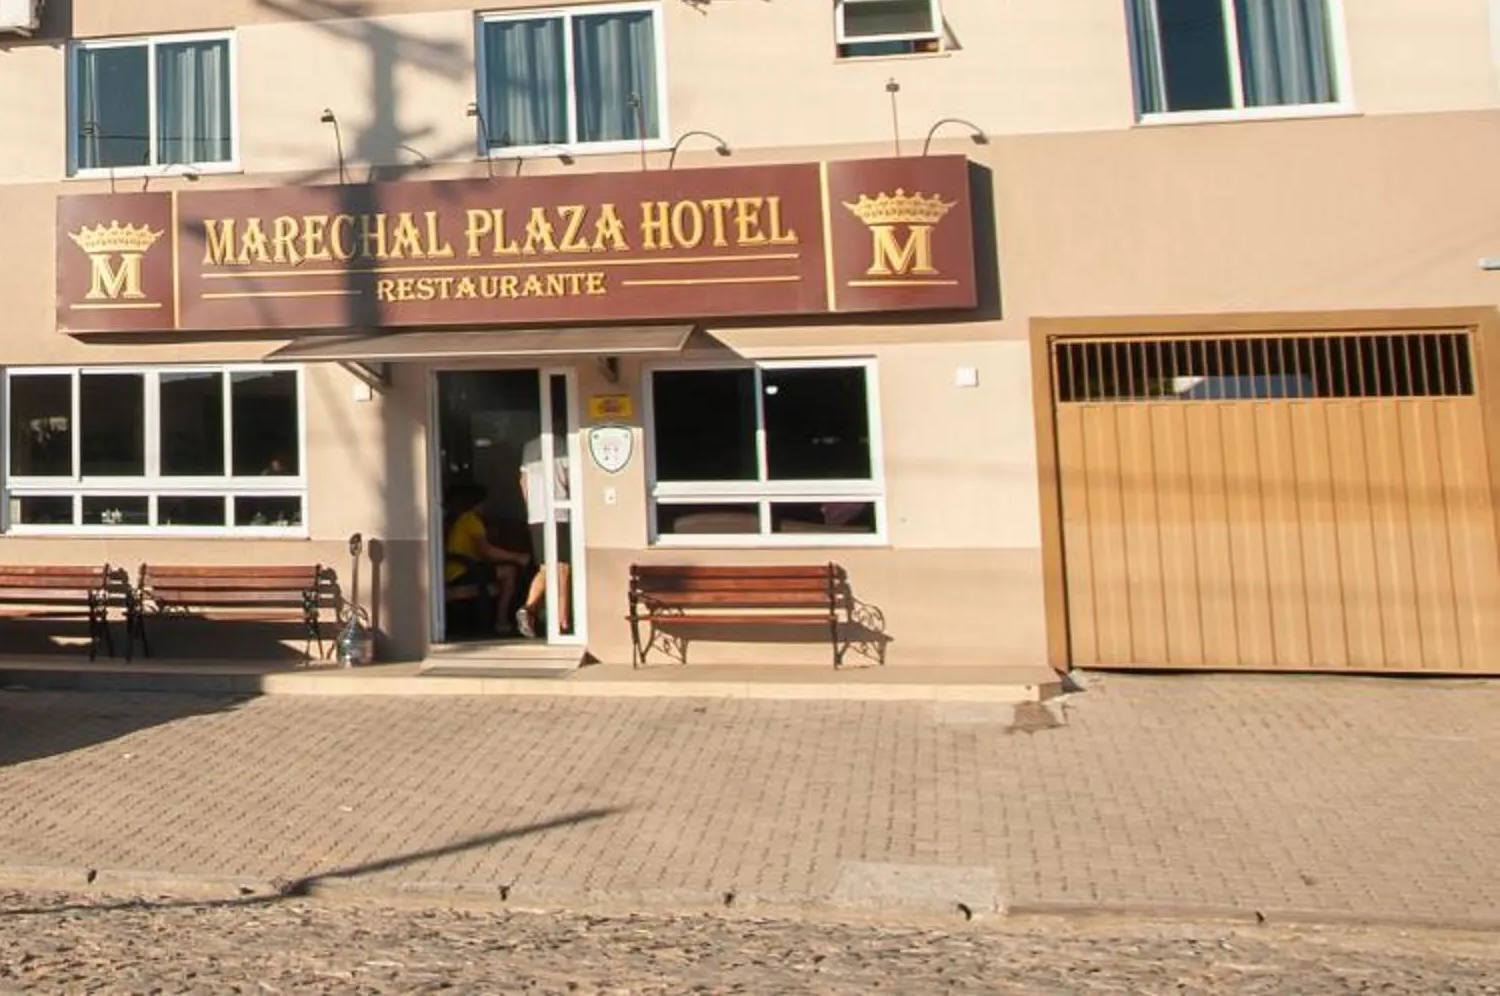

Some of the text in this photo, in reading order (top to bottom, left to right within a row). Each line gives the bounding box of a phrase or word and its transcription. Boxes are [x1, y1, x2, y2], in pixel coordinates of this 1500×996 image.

[202, 196, 799, 266] MARECHAL PLAZA HOTEL
[866, 225, 939, 275] M
[84, 253, 147, 299] M
[377, 272, 606, 302] RESTAURANTE
